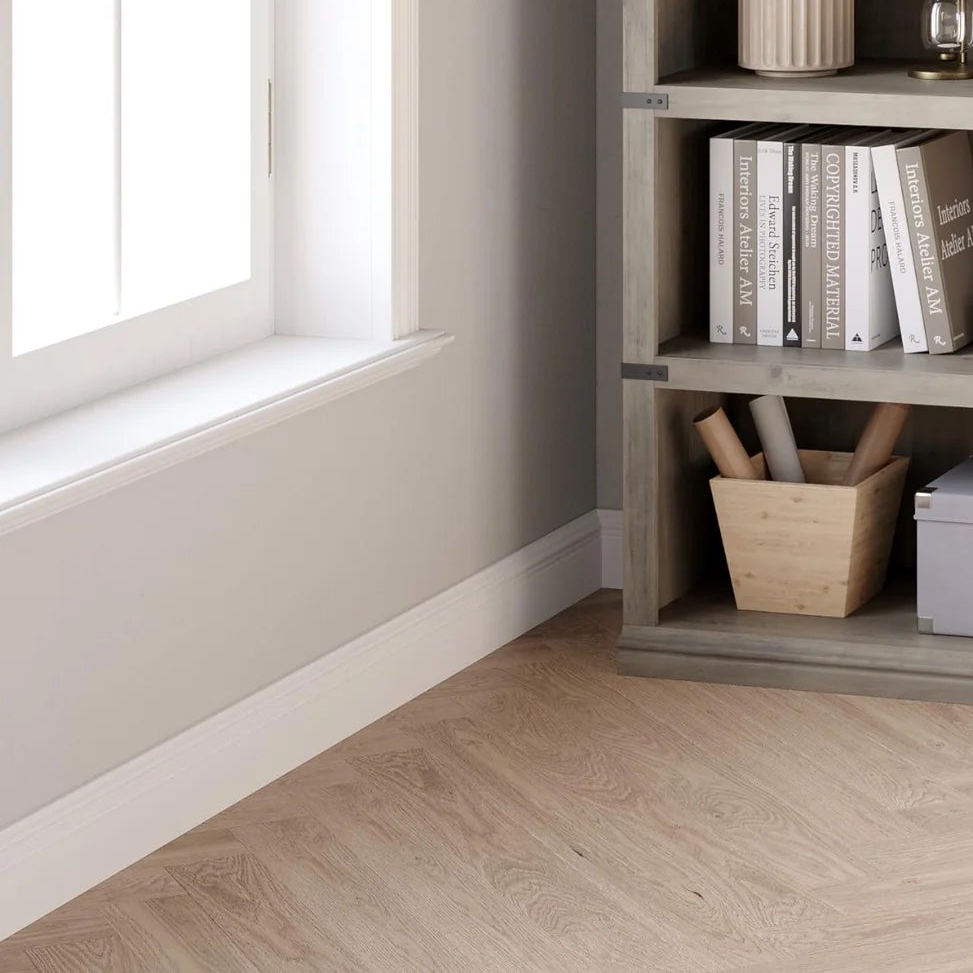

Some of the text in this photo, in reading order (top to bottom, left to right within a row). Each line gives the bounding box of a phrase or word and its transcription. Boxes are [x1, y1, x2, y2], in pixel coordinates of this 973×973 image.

[739, 155, 753, 307] Interiors Atelier AM
[768, 195, 780, 291] Edward Steichen
[808, 152, 819, 248] The Waking Dream
[826, 153, 840, 340] COPYRIGHTED MATERIAL
[905, 162, 943, 316] Interiors Atelier AM
[937, 198, 971, 226] Interiors
[941, 232, 966, 261] Atelier
[895, 242, 906, 274] HALARD
